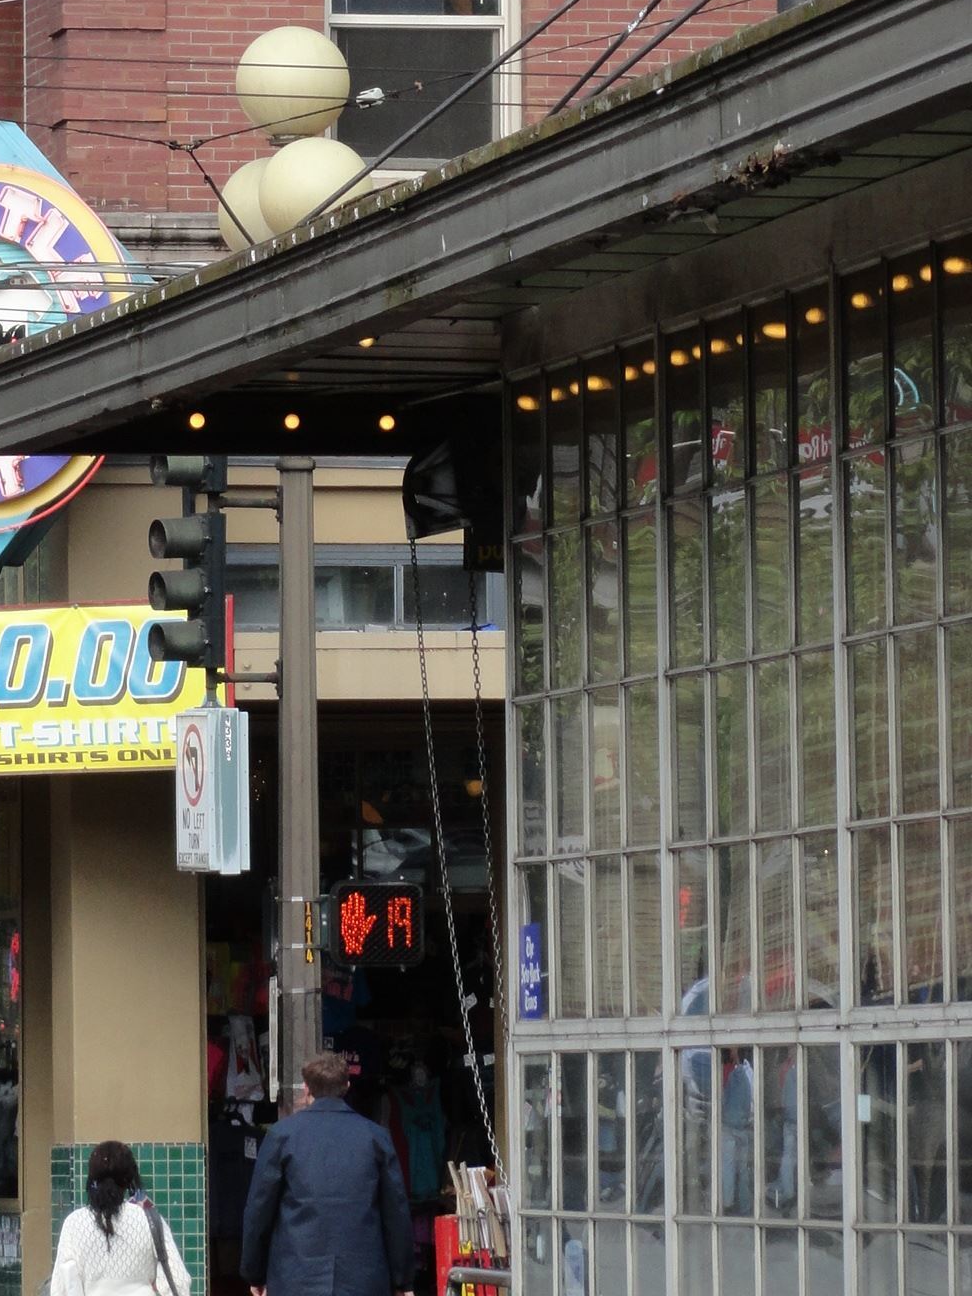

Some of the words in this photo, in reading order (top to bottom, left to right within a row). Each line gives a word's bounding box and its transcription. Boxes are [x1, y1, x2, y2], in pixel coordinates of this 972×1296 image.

[116, 747, 177, 762] ONL
[182, 807, 191, 830] NO
[194, 811, 206, 830] LEFT
[188, 832, 200, 850] TURN
[305, 901, 314, 963] 1414
[387, 896, 412, 948] 19
